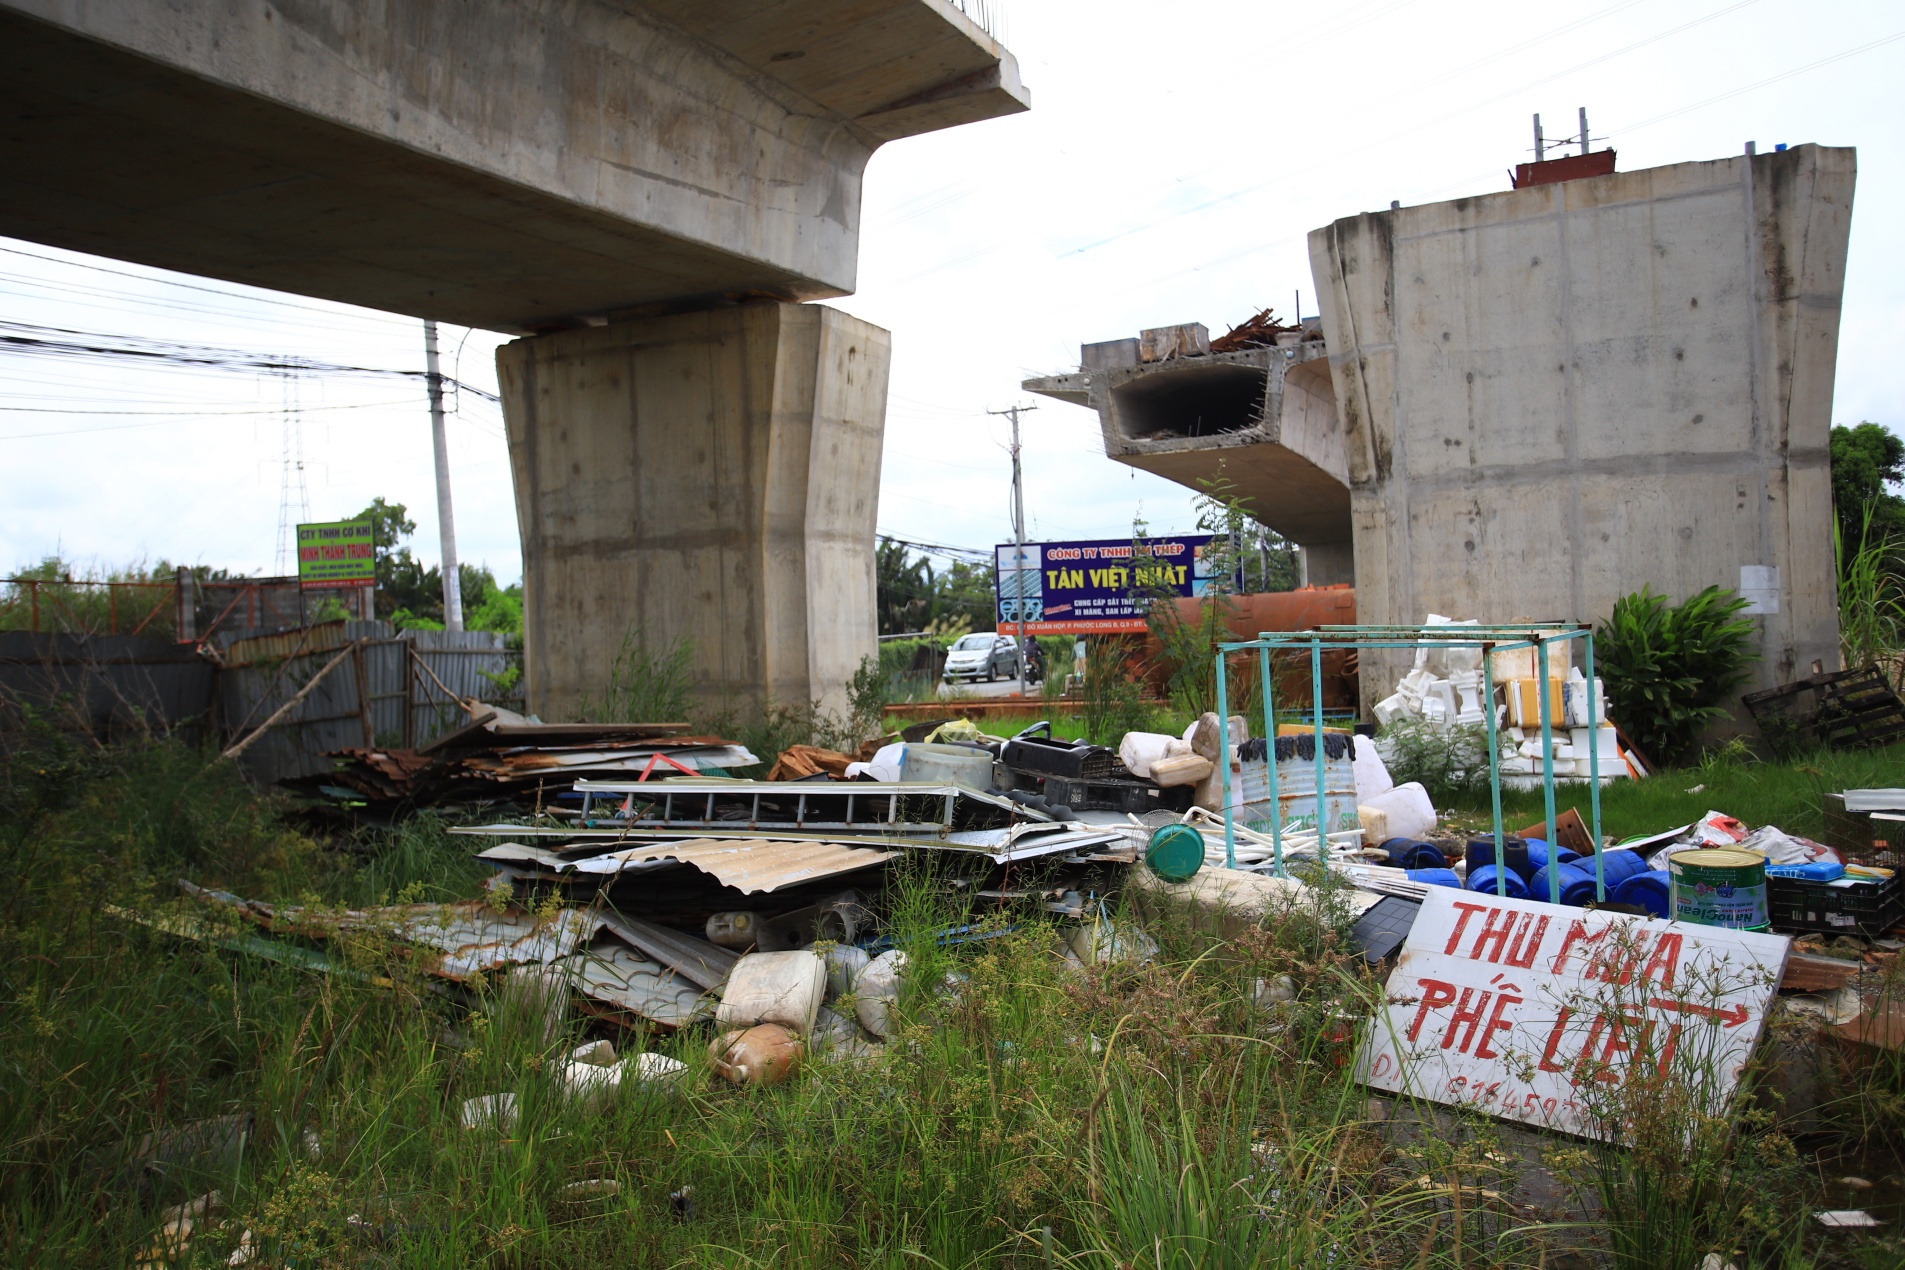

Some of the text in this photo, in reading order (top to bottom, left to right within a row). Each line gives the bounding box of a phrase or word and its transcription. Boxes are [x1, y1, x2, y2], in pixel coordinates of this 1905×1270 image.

[300, 524, 371, 540] CTY TNHH CƠ KHÍ
[300, 546, 319, 562] MINH
[346, 543, 372, 559] TRUNG
[1047, 546, 1081, 560] CÔNG
[1083, 547, 1098, 559] TY
[1099, 546, 1131, 558] TNHH
[1154, 542, 1185, 556] THÉP
[1046, 567, 1084, 589] TÂN
[1088, 565, 1129, 592] VIỆT
[1073, 599, 1092, 607] CUNG
[1074, 608, 1082, 616] XI
[1444, 900, 1683, 991] THU MUA
[1407, 973, 1523, 1060] PHẾ
